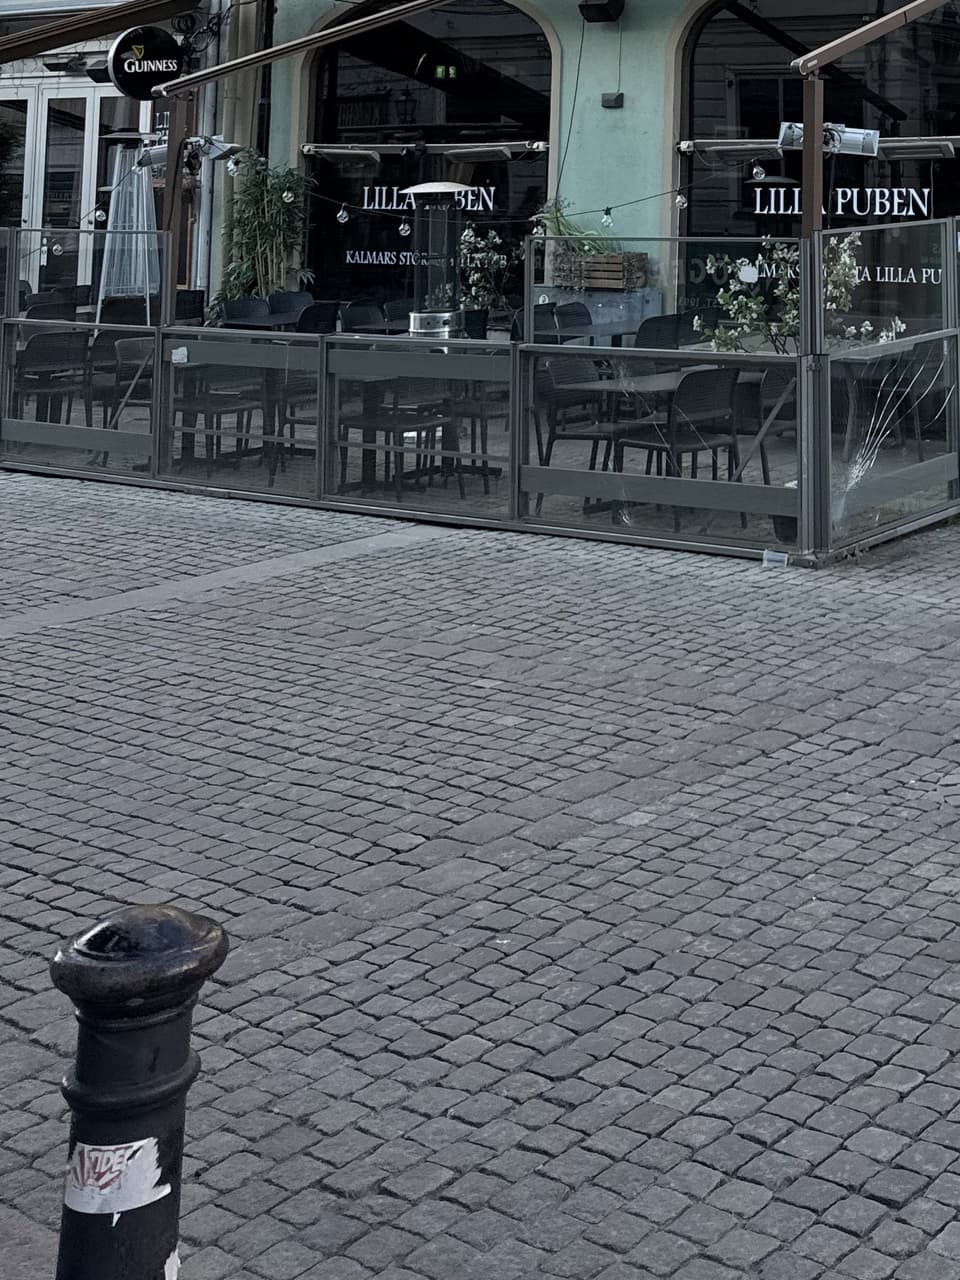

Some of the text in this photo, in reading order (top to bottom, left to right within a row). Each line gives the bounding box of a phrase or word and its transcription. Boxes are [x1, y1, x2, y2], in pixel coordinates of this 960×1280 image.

[124, 59, 178, 73] GUINNESS
[363, 186, 417, 210] LILLA
[754, 187, 930, 216] LILL PUBEN
[346, 250, 397, 265] KALMARS
[876, 265, 917, 283] LILLA
[921, 268, 942, 285] PU
